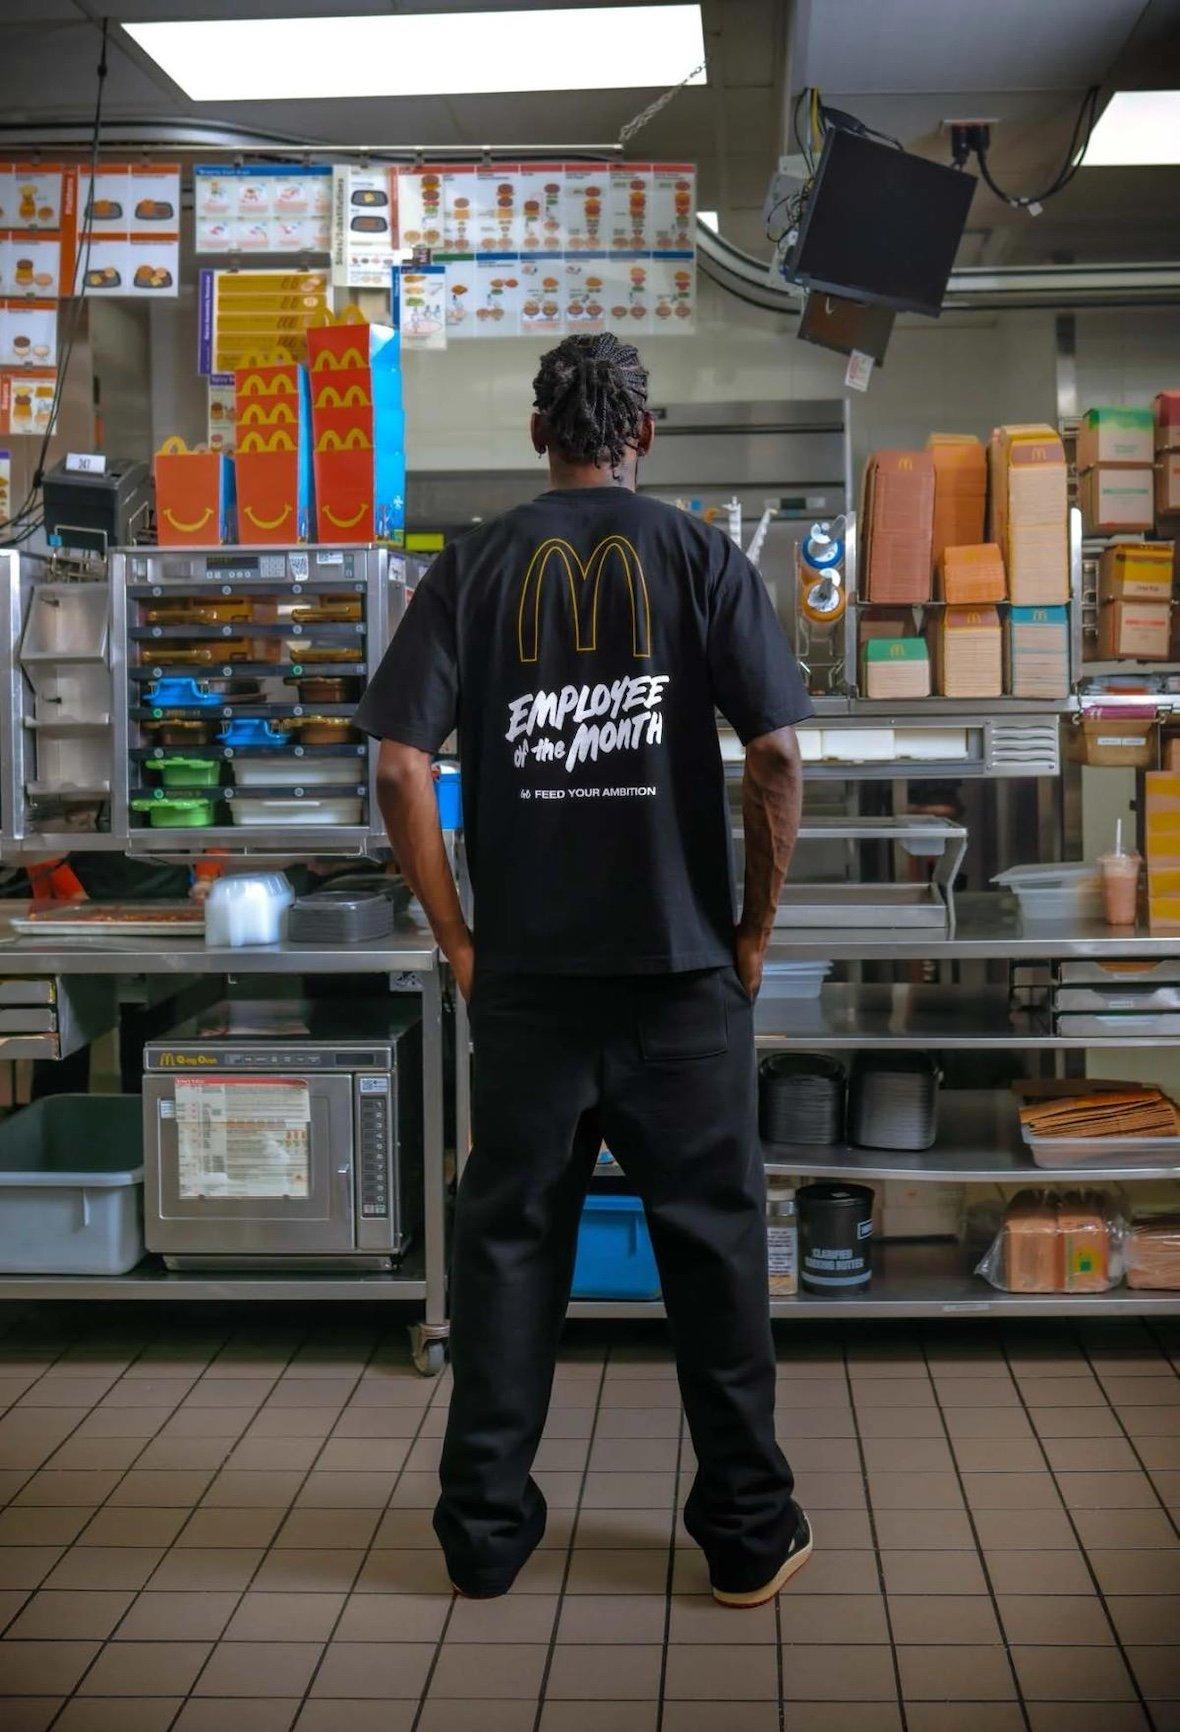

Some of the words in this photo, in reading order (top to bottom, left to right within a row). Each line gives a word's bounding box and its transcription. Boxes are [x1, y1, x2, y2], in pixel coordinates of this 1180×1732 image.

[505, 675, 670, 742] EMPLOYEE
[514, 738, 529, 768] of
[530, 737, 567, 762] the
[565, 711, 663, 773] MONTH
[535, 790, 565, 799] FEED
[568, 788, 600, 798] YOUR
[602, 786, 656, 797] AMBITION
